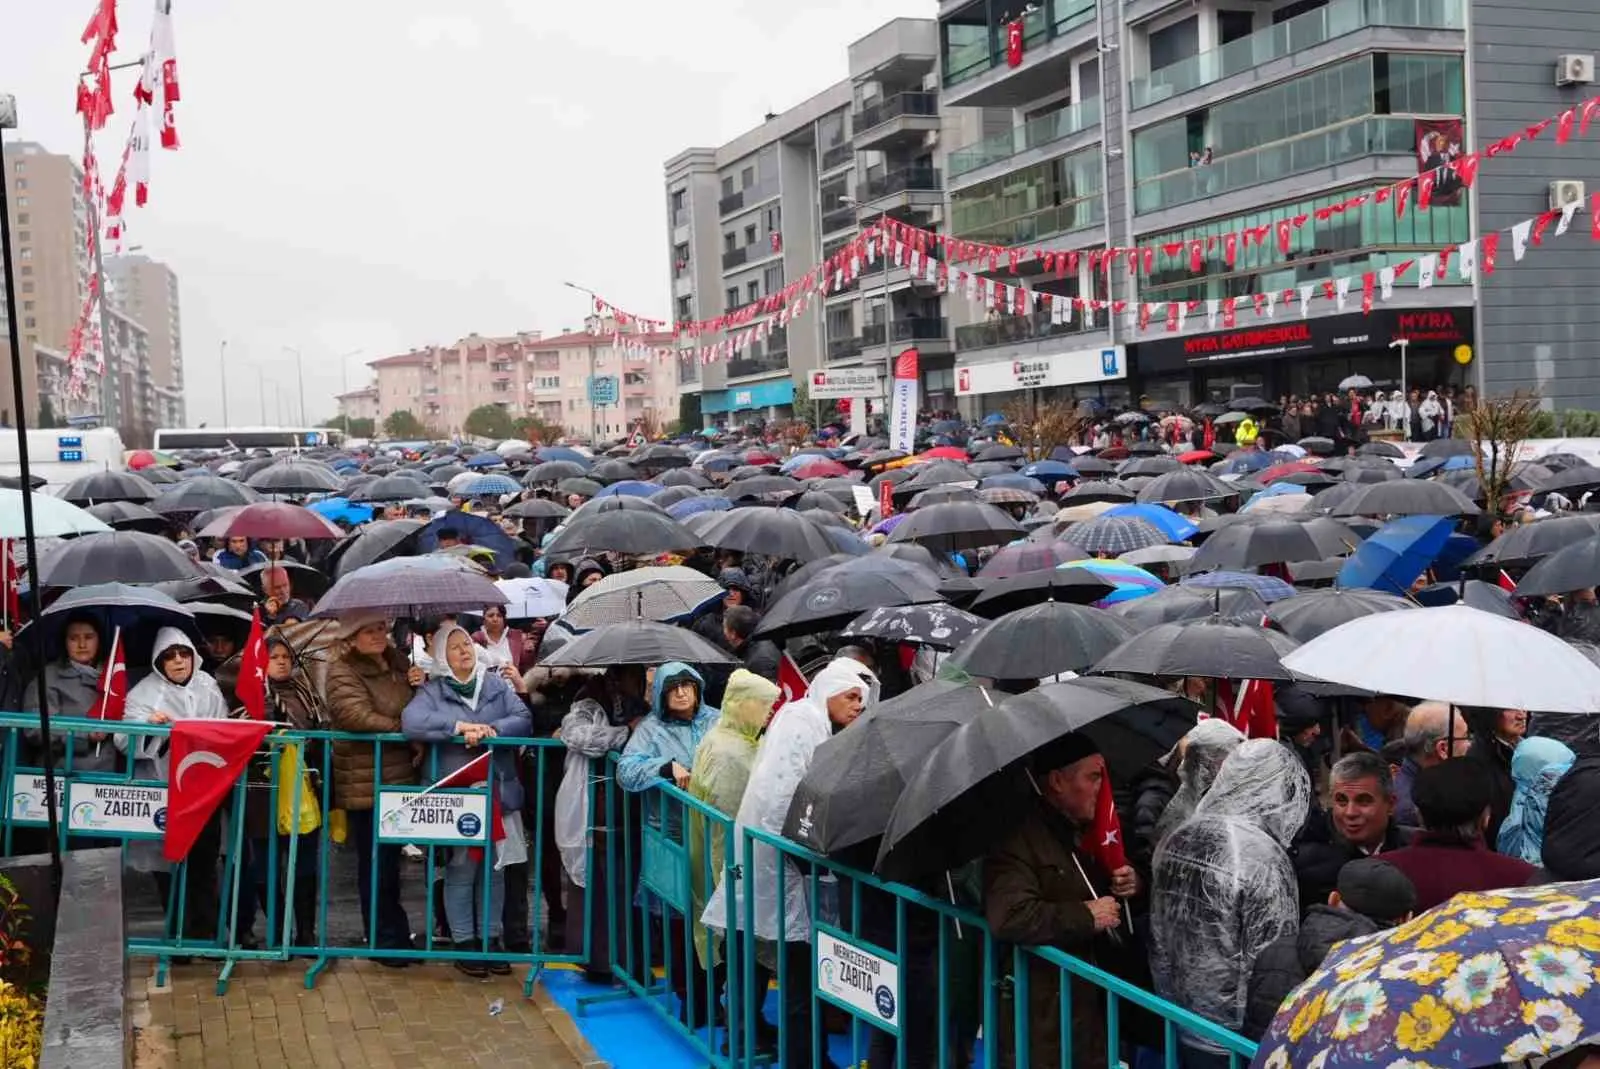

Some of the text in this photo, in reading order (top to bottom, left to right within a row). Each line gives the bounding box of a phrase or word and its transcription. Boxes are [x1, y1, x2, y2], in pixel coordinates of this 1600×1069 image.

[1398, 311, 1454, 328] MYRA
[104, 800, 151, 817] ZABITA
[410, 807, 454, 824] ZABITA
[839, 961, 873, 995] ZABITA
